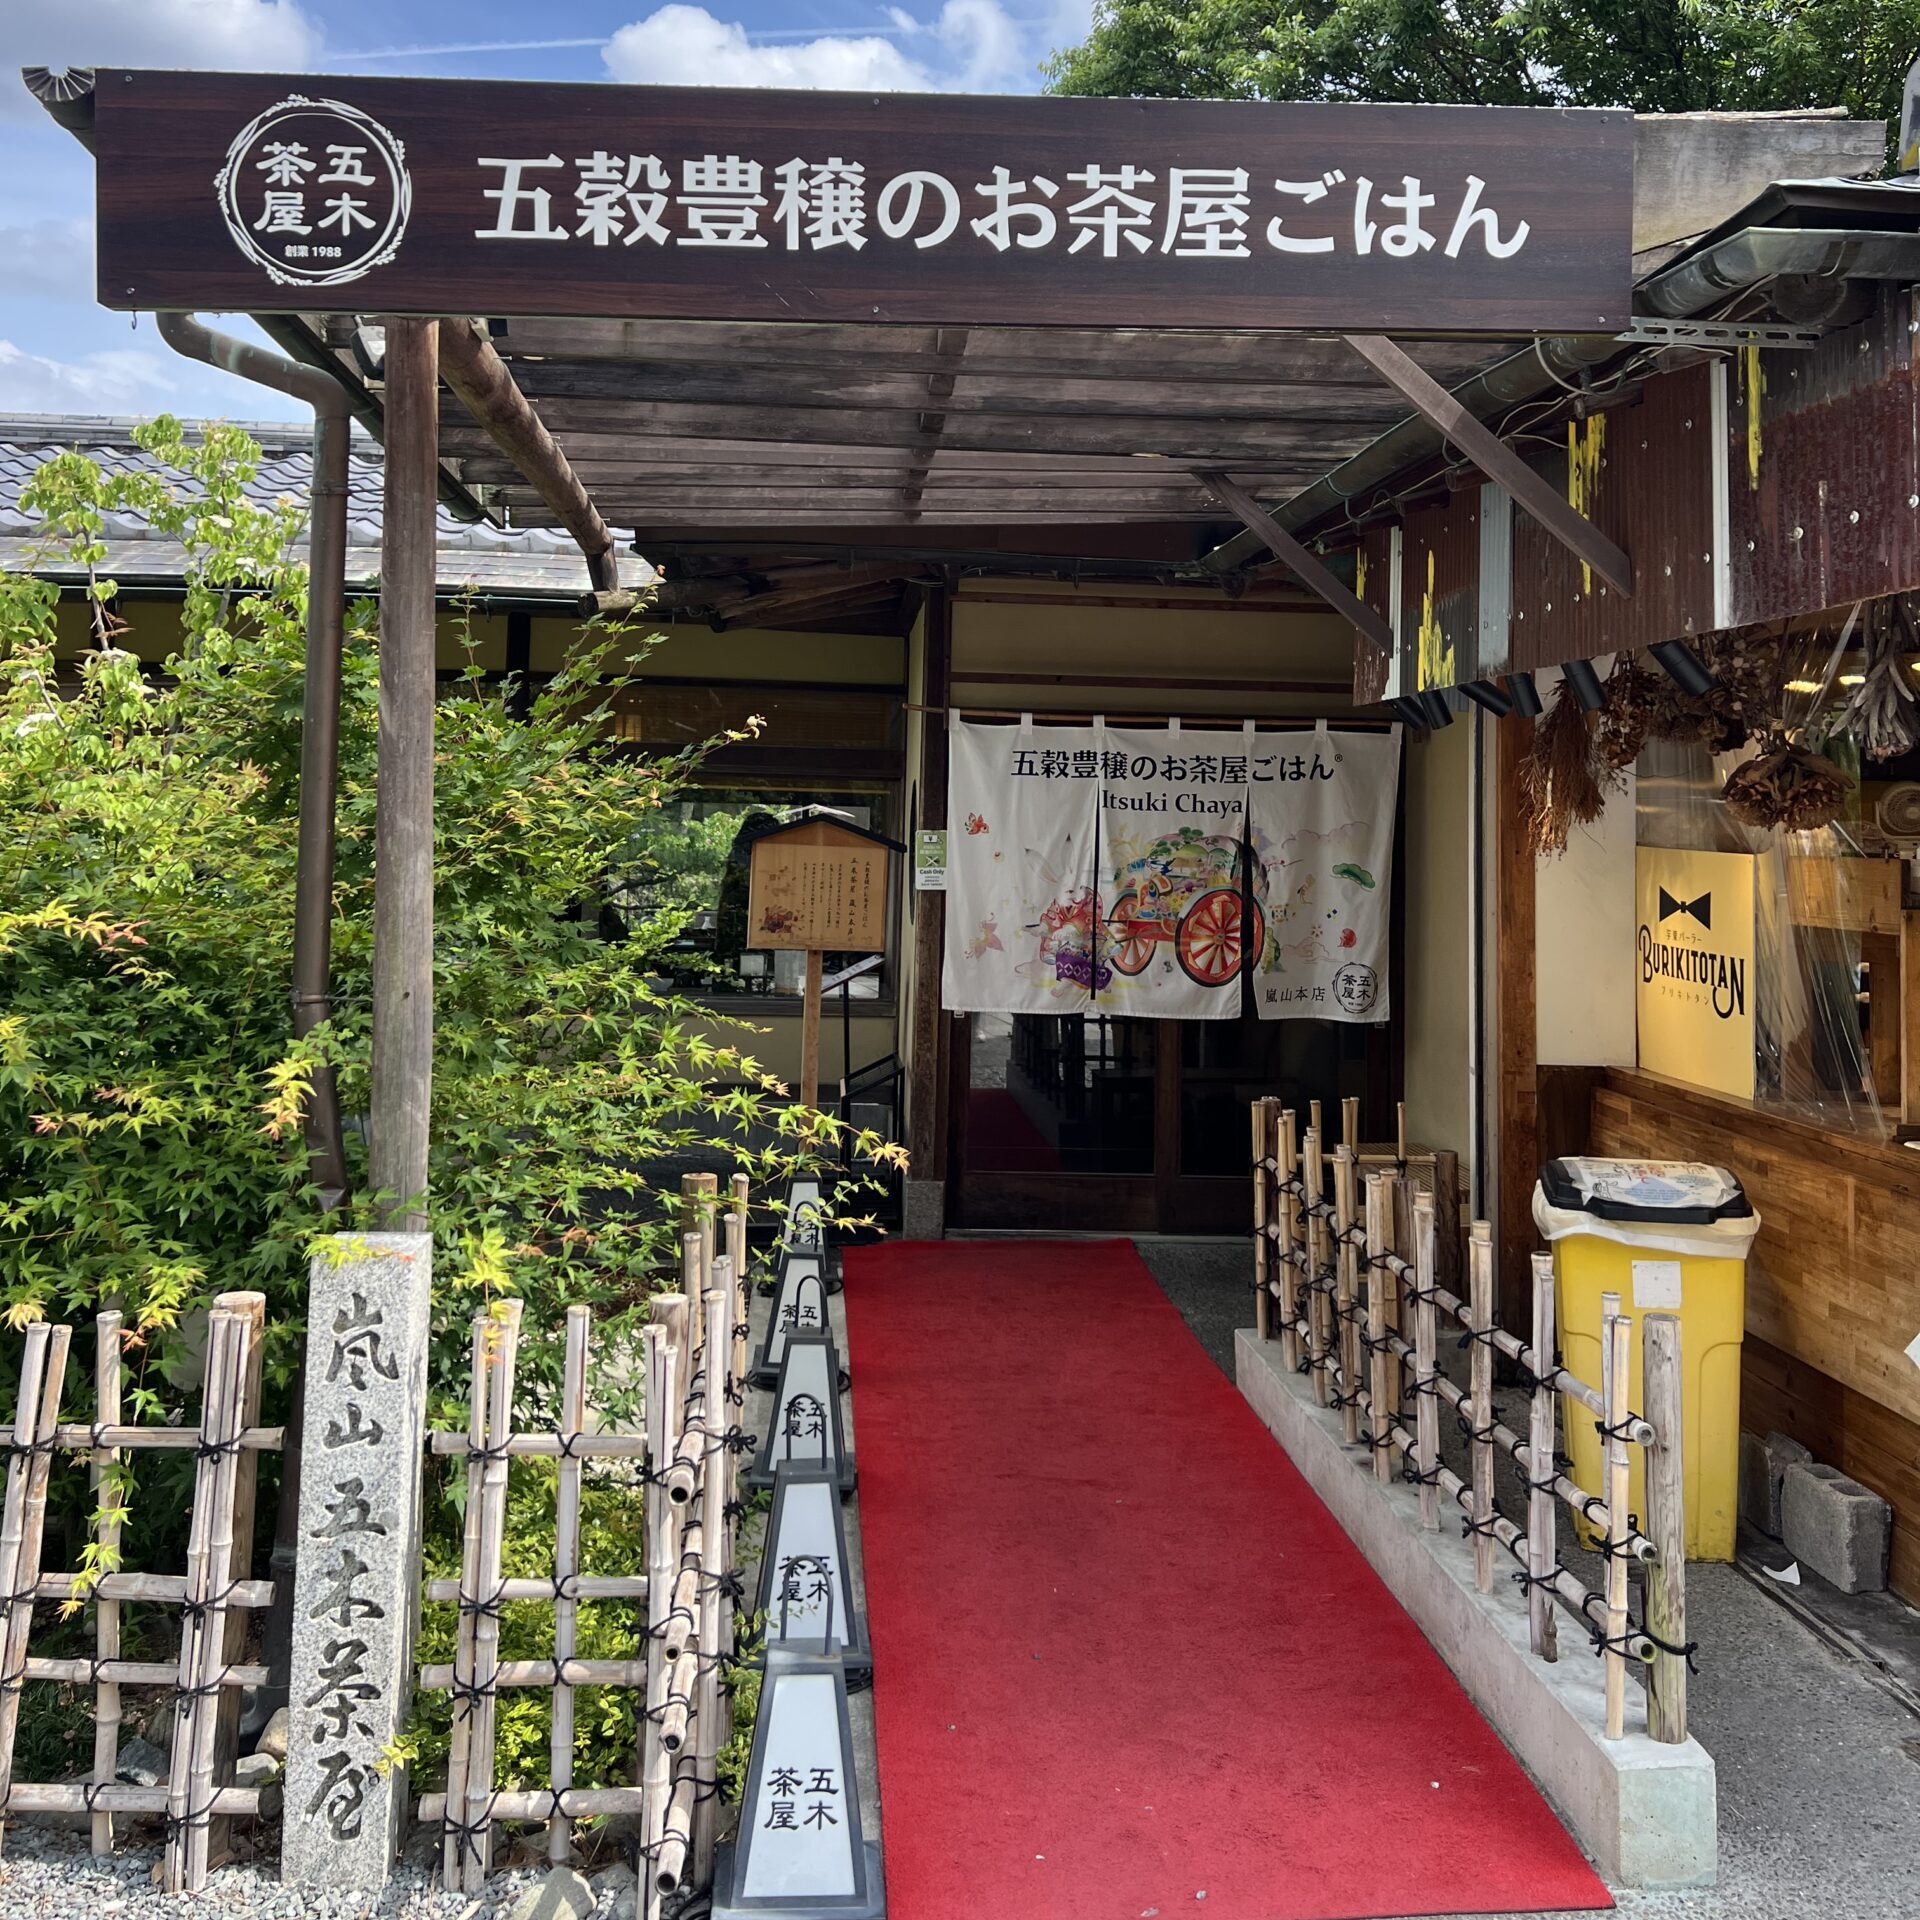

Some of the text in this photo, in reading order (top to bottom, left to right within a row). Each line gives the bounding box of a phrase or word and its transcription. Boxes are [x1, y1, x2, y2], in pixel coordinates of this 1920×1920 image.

[474, 150, 1531, 258] 五穀豊穣のお茶屋ごはん
[311, 246, 342, 258] 1988
[1101, 789, 1243, 819] Itsuki Chaya
[1264, 985, 1326, 1004] 嵐山本店
[763, 1766, 804, 1831] 茶屋
[803, 1767, 839, 1831] 五木
